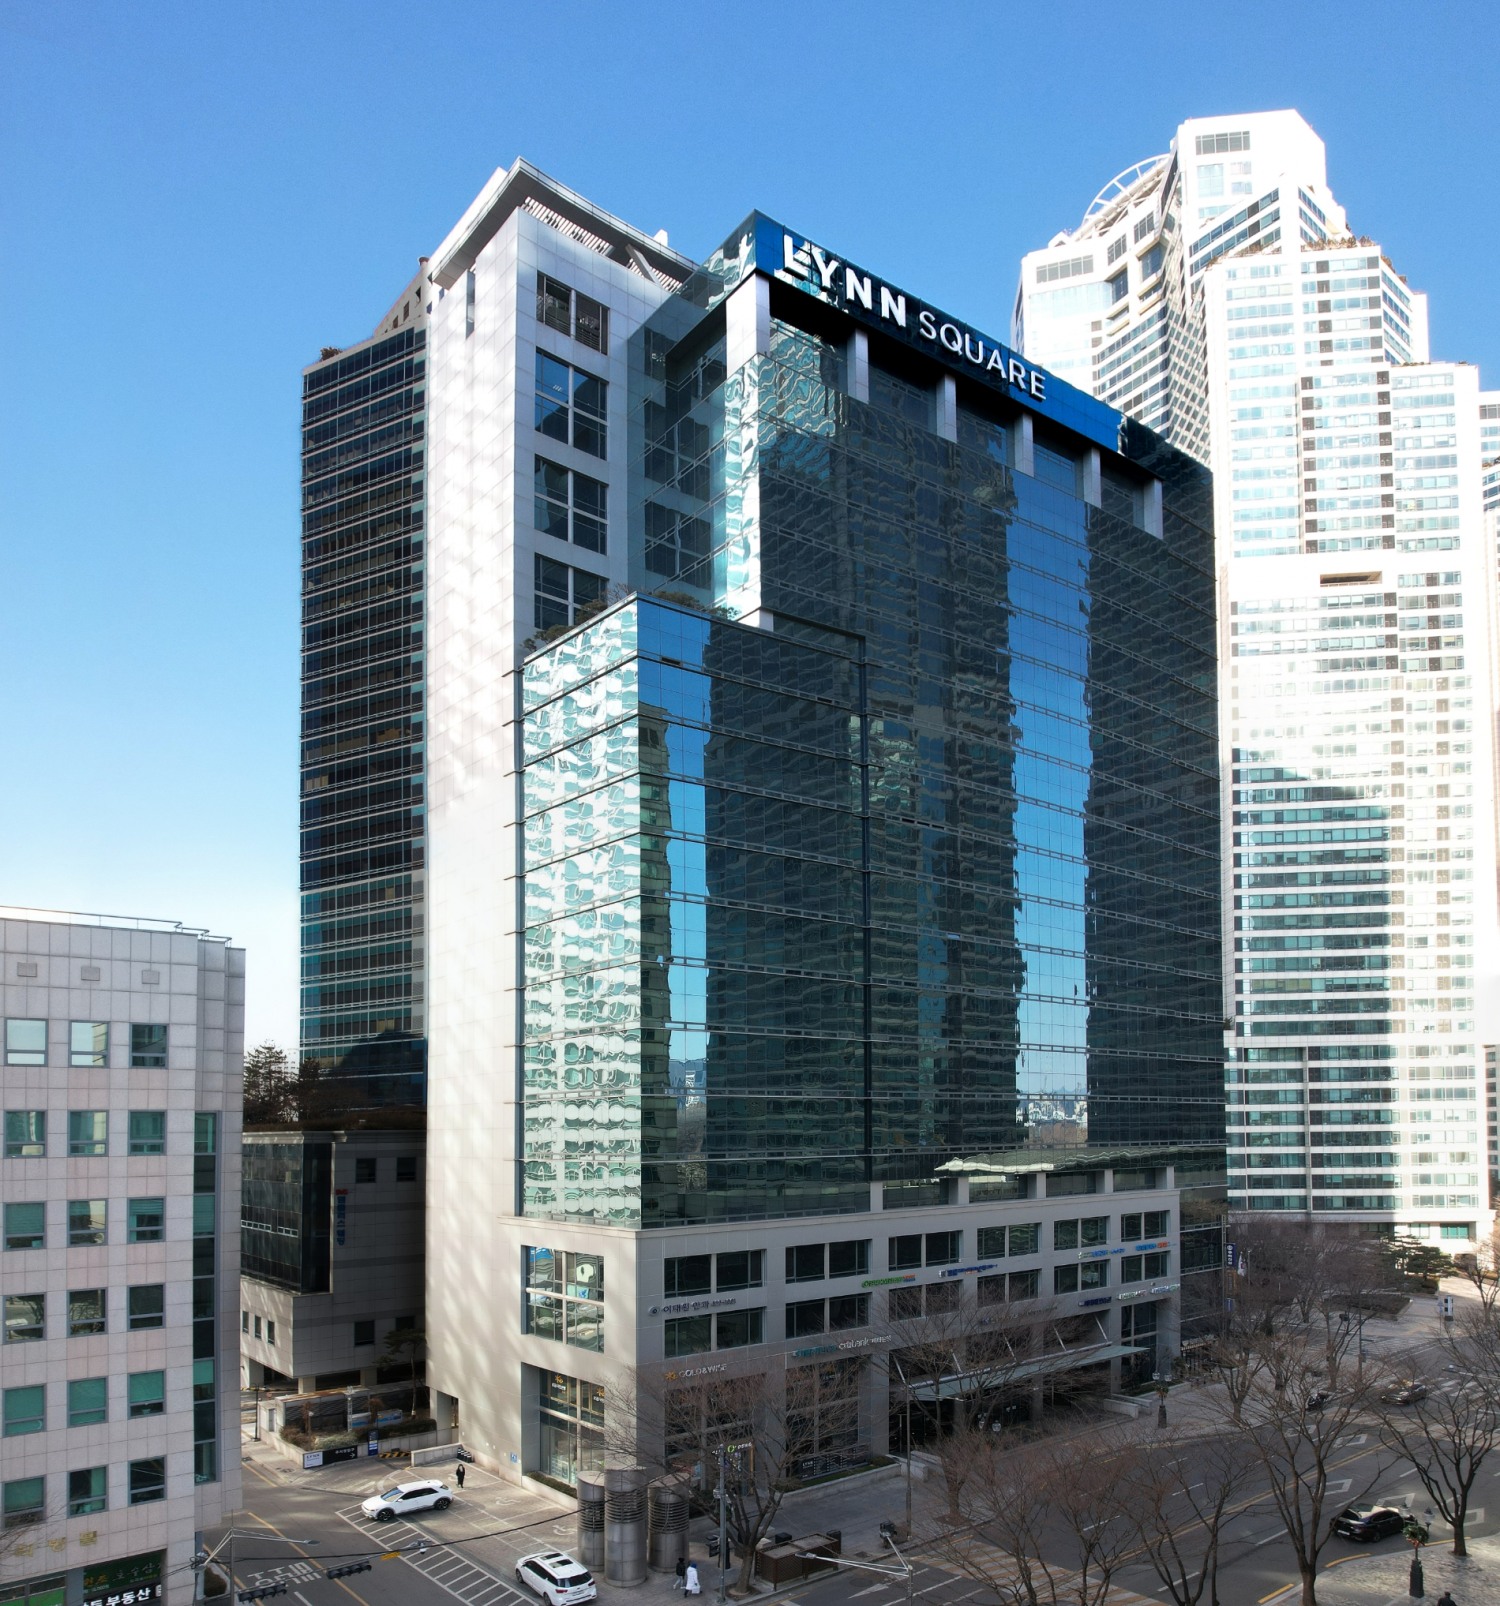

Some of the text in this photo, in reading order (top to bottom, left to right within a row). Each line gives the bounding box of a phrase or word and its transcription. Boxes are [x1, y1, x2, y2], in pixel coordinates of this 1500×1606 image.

[783, 234, 1047, 401] LYNN SQUARE
[83, 1588, 151, 1606] 트부동산
